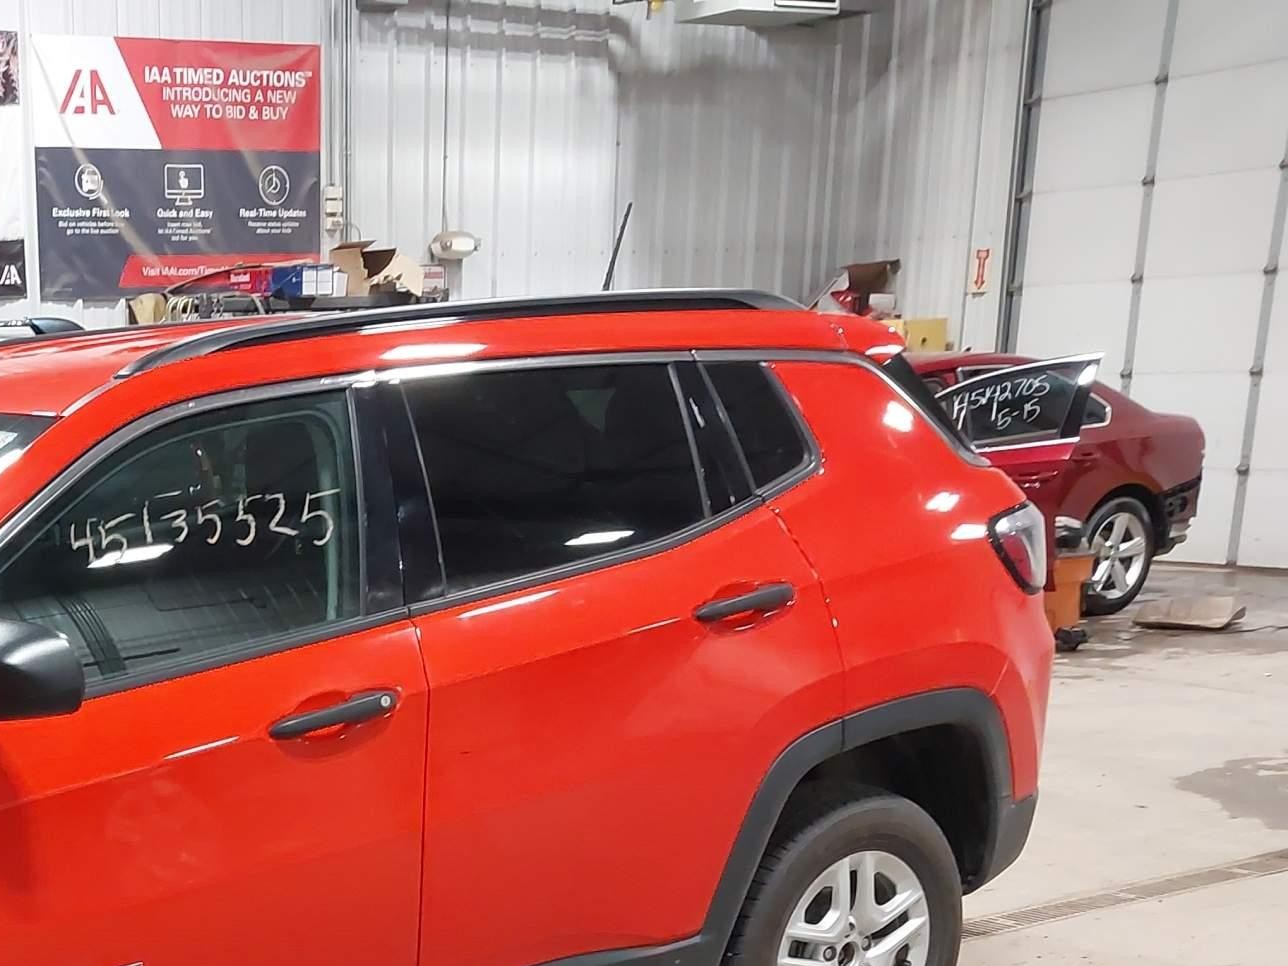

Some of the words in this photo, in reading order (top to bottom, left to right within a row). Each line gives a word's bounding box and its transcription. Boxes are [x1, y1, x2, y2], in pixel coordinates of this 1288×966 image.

[144, 66, 171, 84] IAA
[173, 67, 224, 86] TIMED
[162, 87, 251, 104] INTRODUCING
[254, 89, 264, 104] A
[267, 90, 297, 105] NEW
[171, 104, 200, 119] WAY
[204, 104, 223, 119] TO
[226, 105, 246, 120] BID
[248, 106, 259, 120] &
[262, 106, 289, 121] BUY
[52, 207, 91, 218] Exclusive
[157, 208, 177, 218] Quick
[179, 209, 193, 218] and
[195, 208, 213, 220] Easy
[70, 488, 341, 564] 45135525
